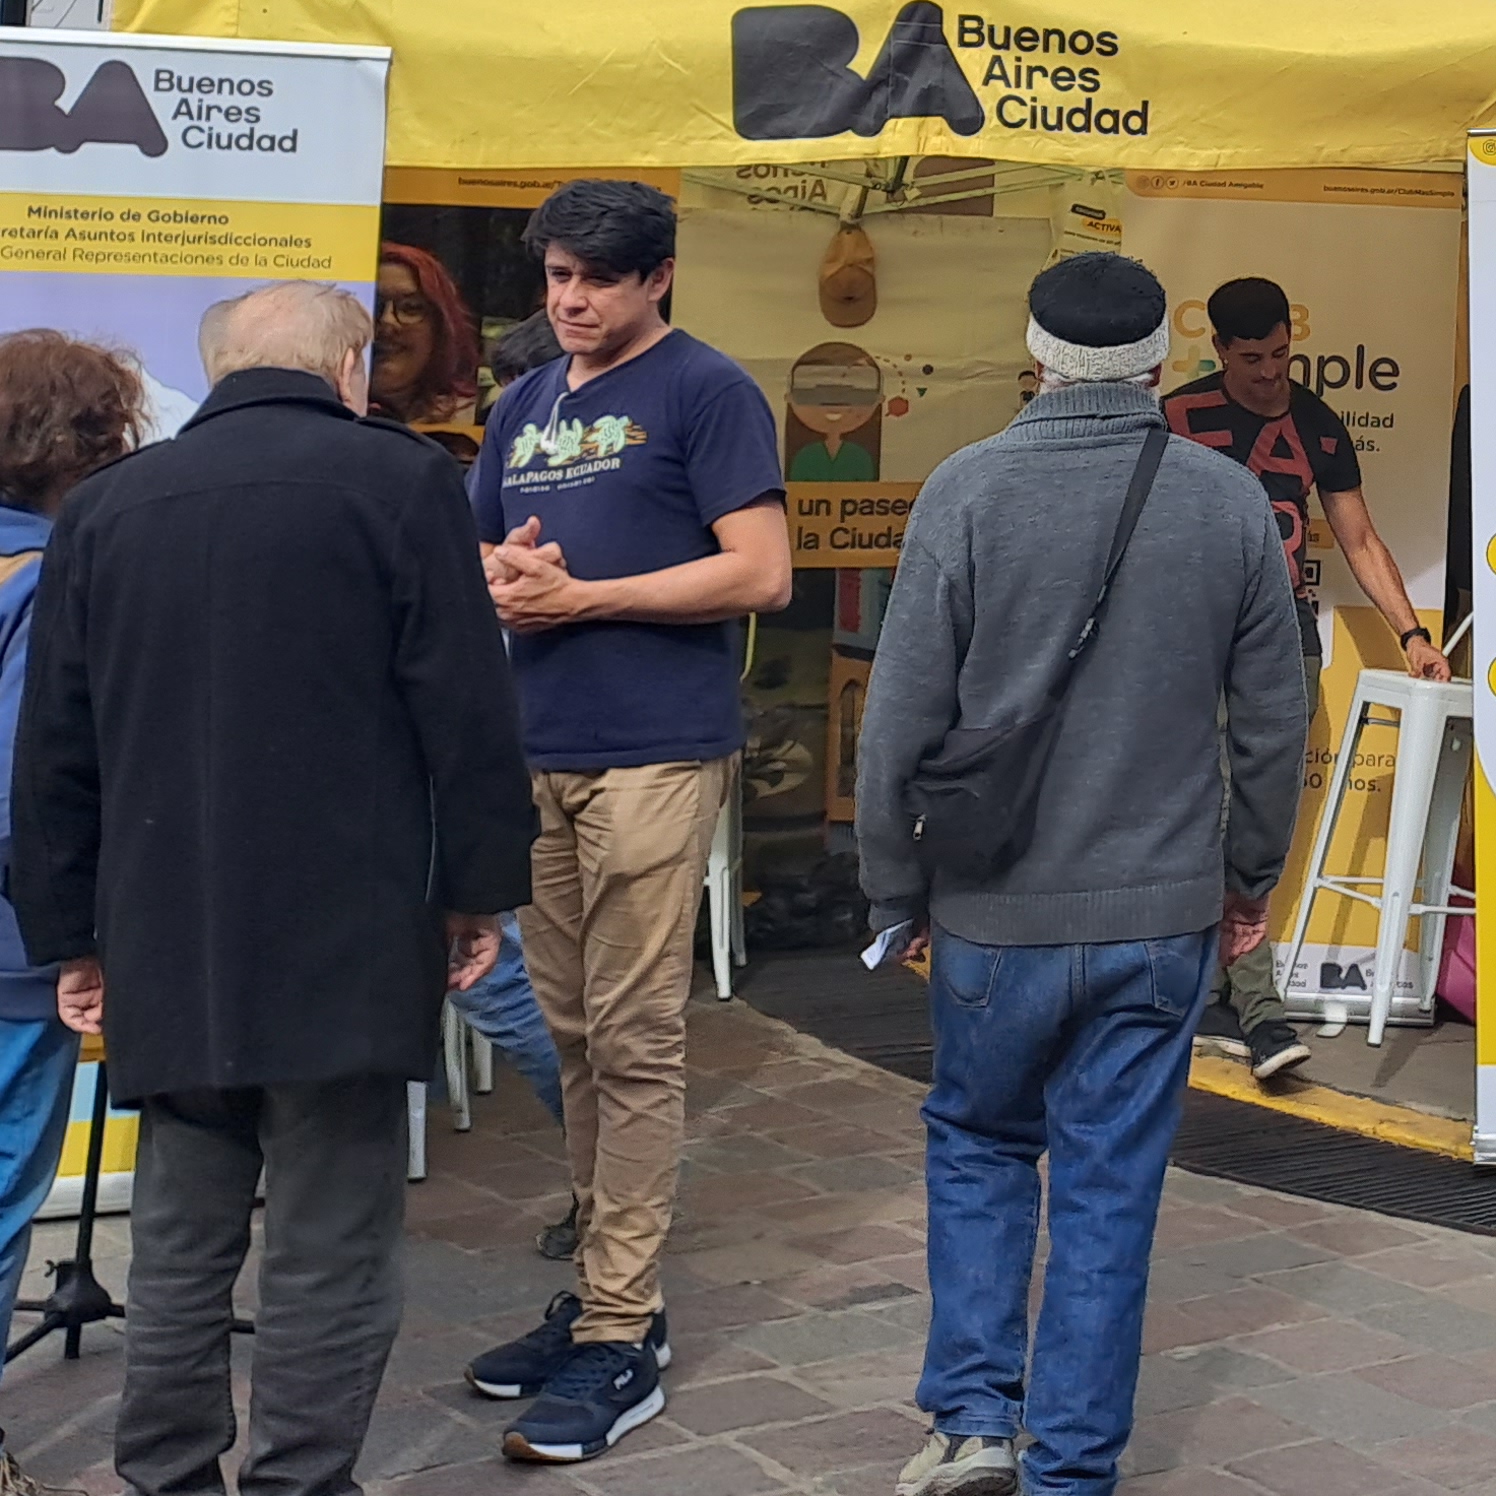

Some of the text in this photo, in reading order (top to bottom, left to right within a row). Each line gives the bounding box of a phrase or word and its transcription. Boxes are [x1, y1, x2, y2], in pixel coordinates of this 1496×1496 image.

[956, 14, 1119, 57] Buenos
[153, 69, 274, 97] Buenos
[731, 0, 986, 141] BA
[981, 56, 1101, 94] Aires
[171, 98, 261, 124] Aires
[995, 94, 1150, 137] Ciudad
[181, 125, 298, 153] Ciudad
[27, 205, 229, 226] Ministerio de Gobierno
[1087, 221, 1122, 233] ACTIVA
[64, 227, 135, 243] Asuntos
[141, 229, 312, 249] Interjurisdiccionales
[0, 246, 332, 270] General Representaciones de la Ciudad
[565, 457, 621, 481] ECUADOR
[797, 498, 832, 517] un
[796, 525, 820, 551] la
[1353, 753, 1395, 771] para
[1320, 962, 1367, 991] BA
